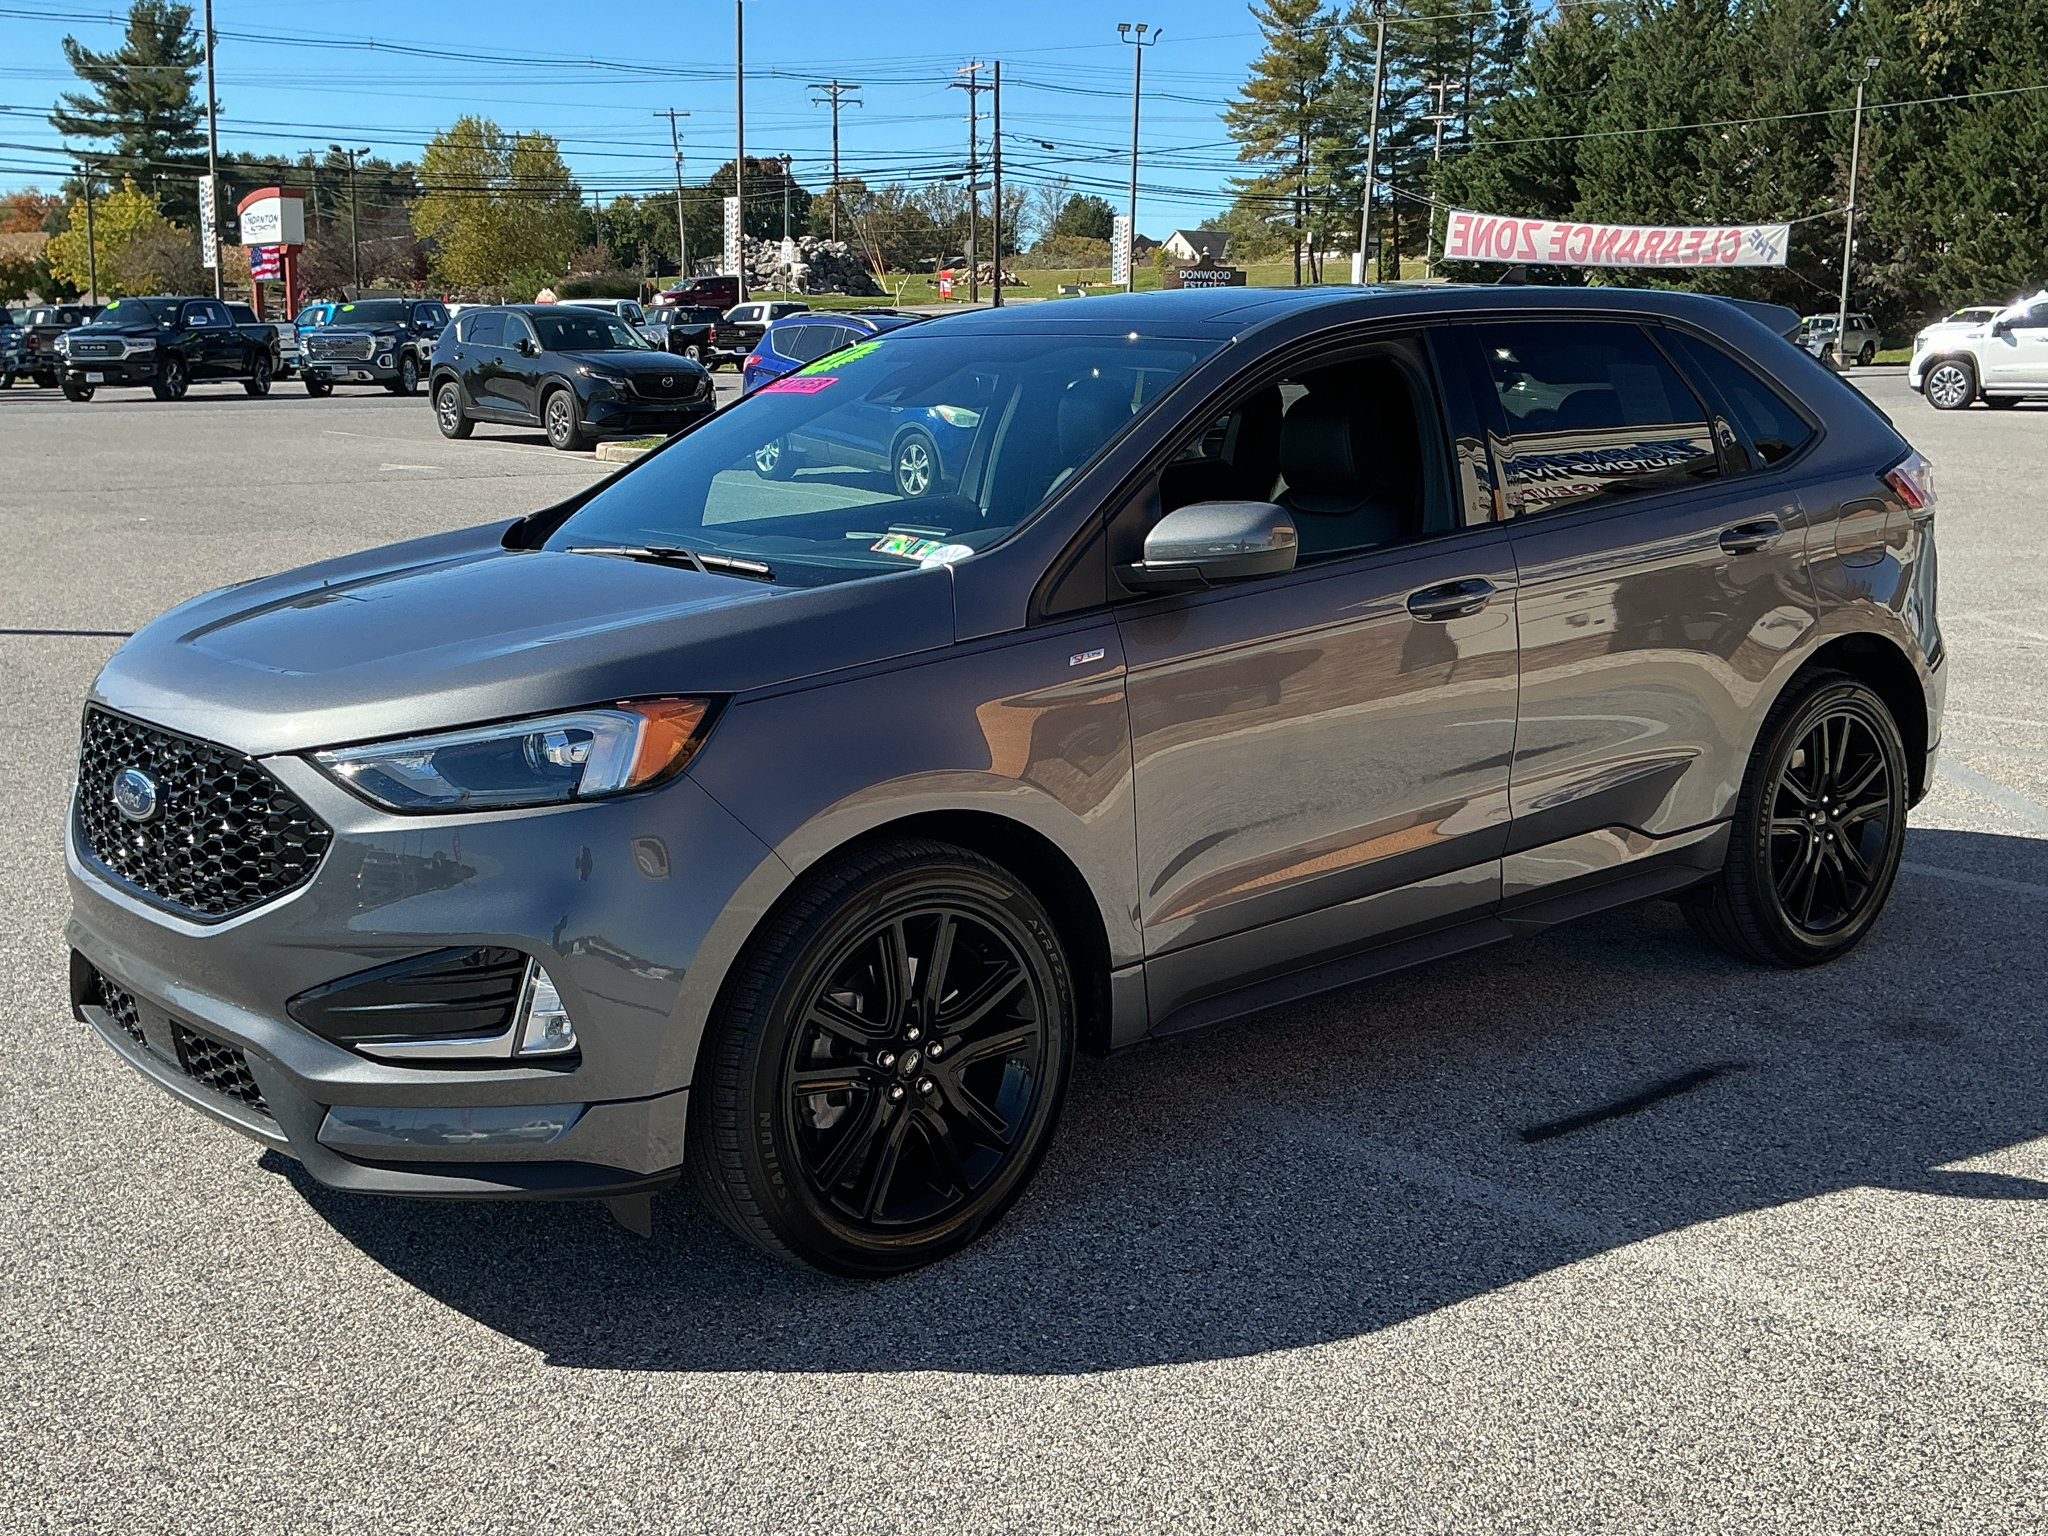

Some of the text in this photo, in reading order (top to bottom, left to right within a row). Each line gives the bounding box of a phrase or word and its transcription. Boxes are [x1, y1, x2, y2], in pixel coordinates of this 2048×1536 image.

[244, 213, 279, 225] THORNTON
[1179, 270, 1231, 280] DONWOOD
[760, 1112, 790, 1200] SAILUN
